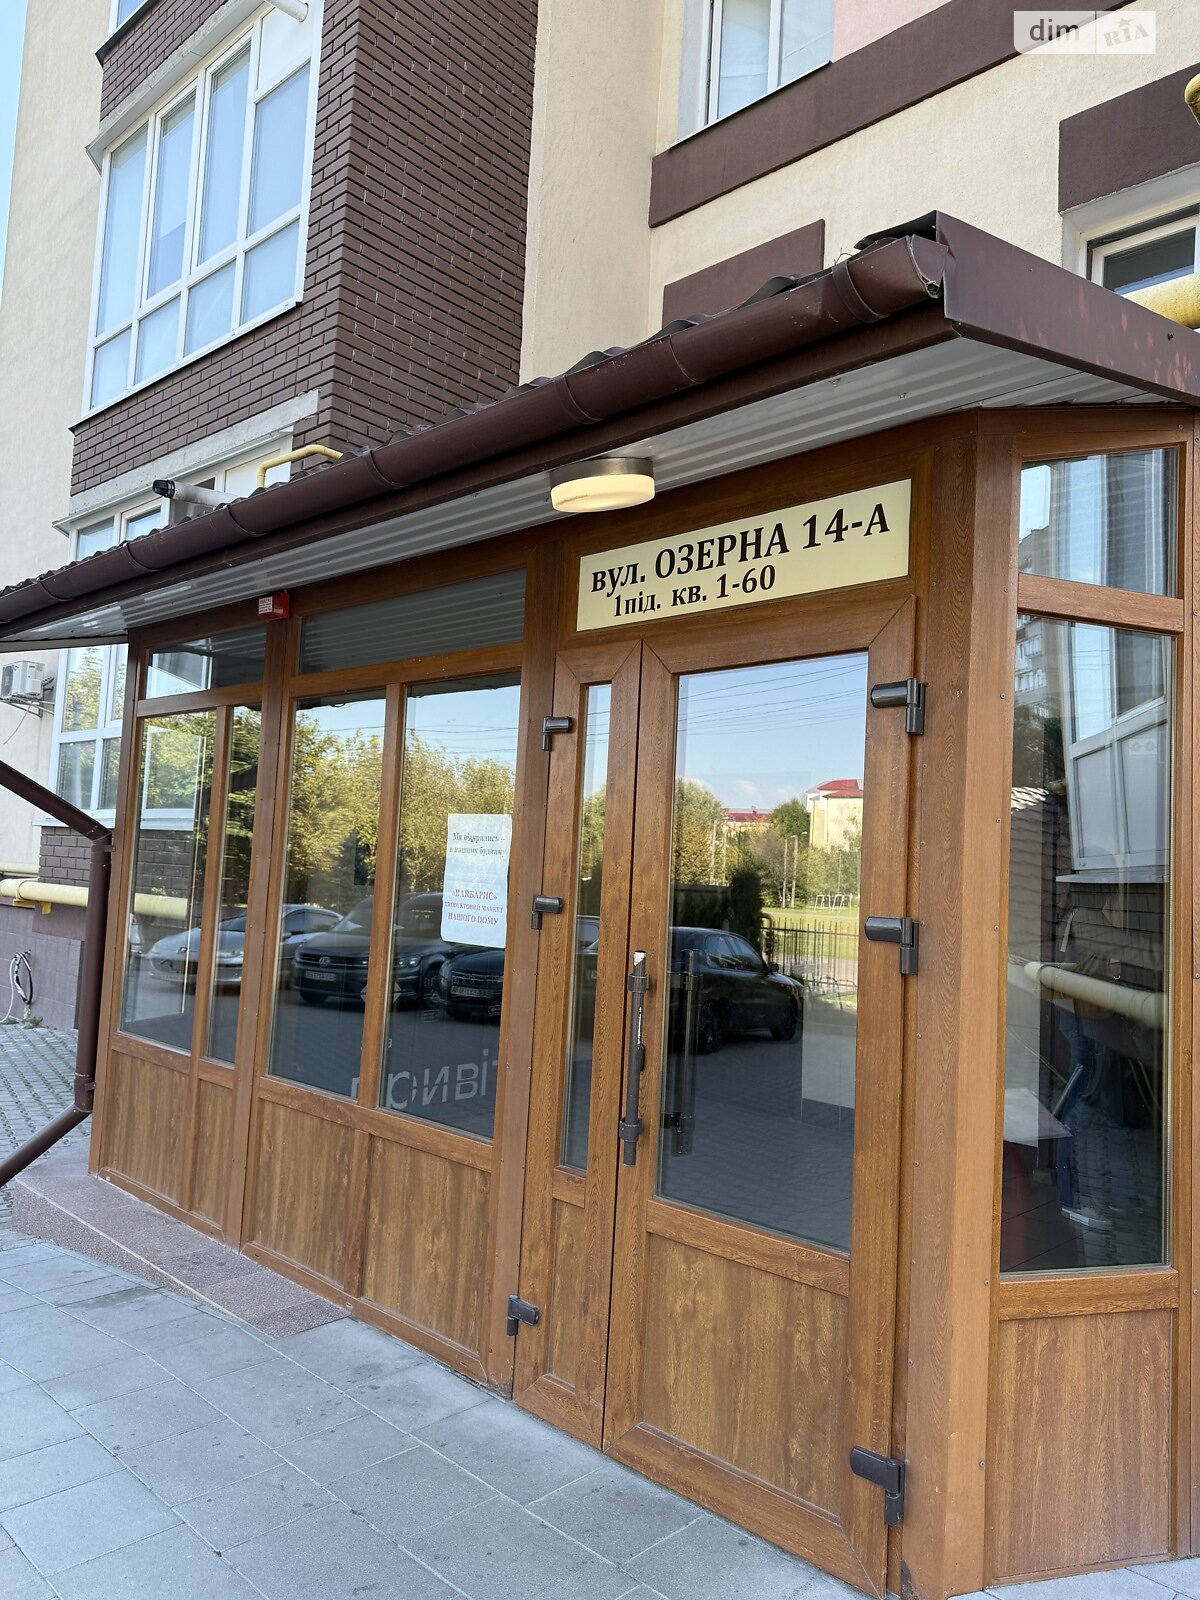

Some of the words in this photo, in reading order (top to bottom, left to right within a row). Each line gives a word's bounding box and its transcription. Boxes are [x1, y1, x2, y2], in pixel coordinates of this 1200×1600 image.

[591, 562, 646, 597] вул.
[654, 522, 790, 579] ОЗЕРНА
[801, 503, 890, 549] 14-А
[614, 591, 661, 616] 1під.
[671, 585, 707, 606] кв.
[716, 564, 776, 599] 1-60
[447, 912, 477, 923] НАШОГО
